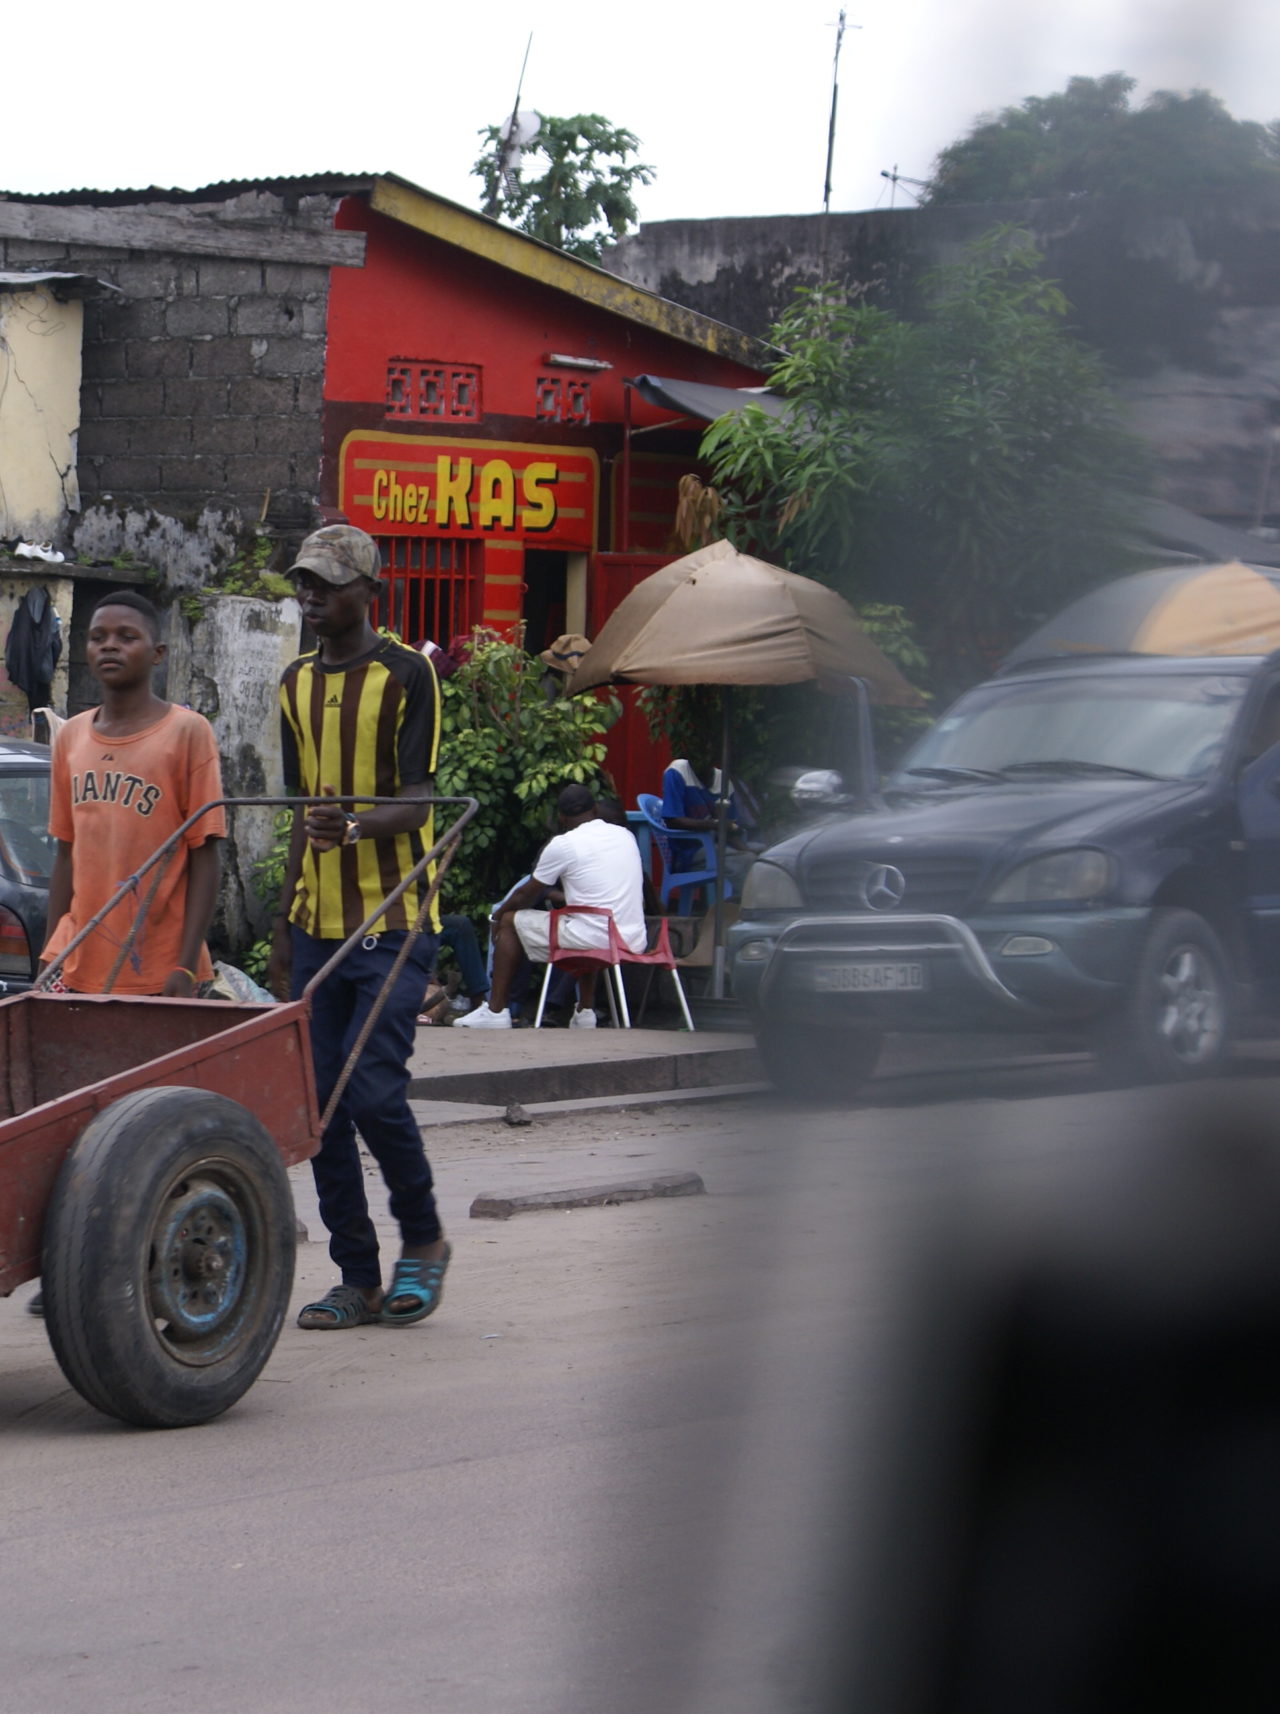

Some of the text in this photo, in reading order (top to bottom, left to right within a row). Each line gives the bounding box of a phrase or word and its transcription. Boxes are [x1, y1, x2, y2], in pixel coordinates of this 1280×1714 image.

[373, 455, 559, 531] Chez KAS
[73, 770, 161, 816] IANTS
